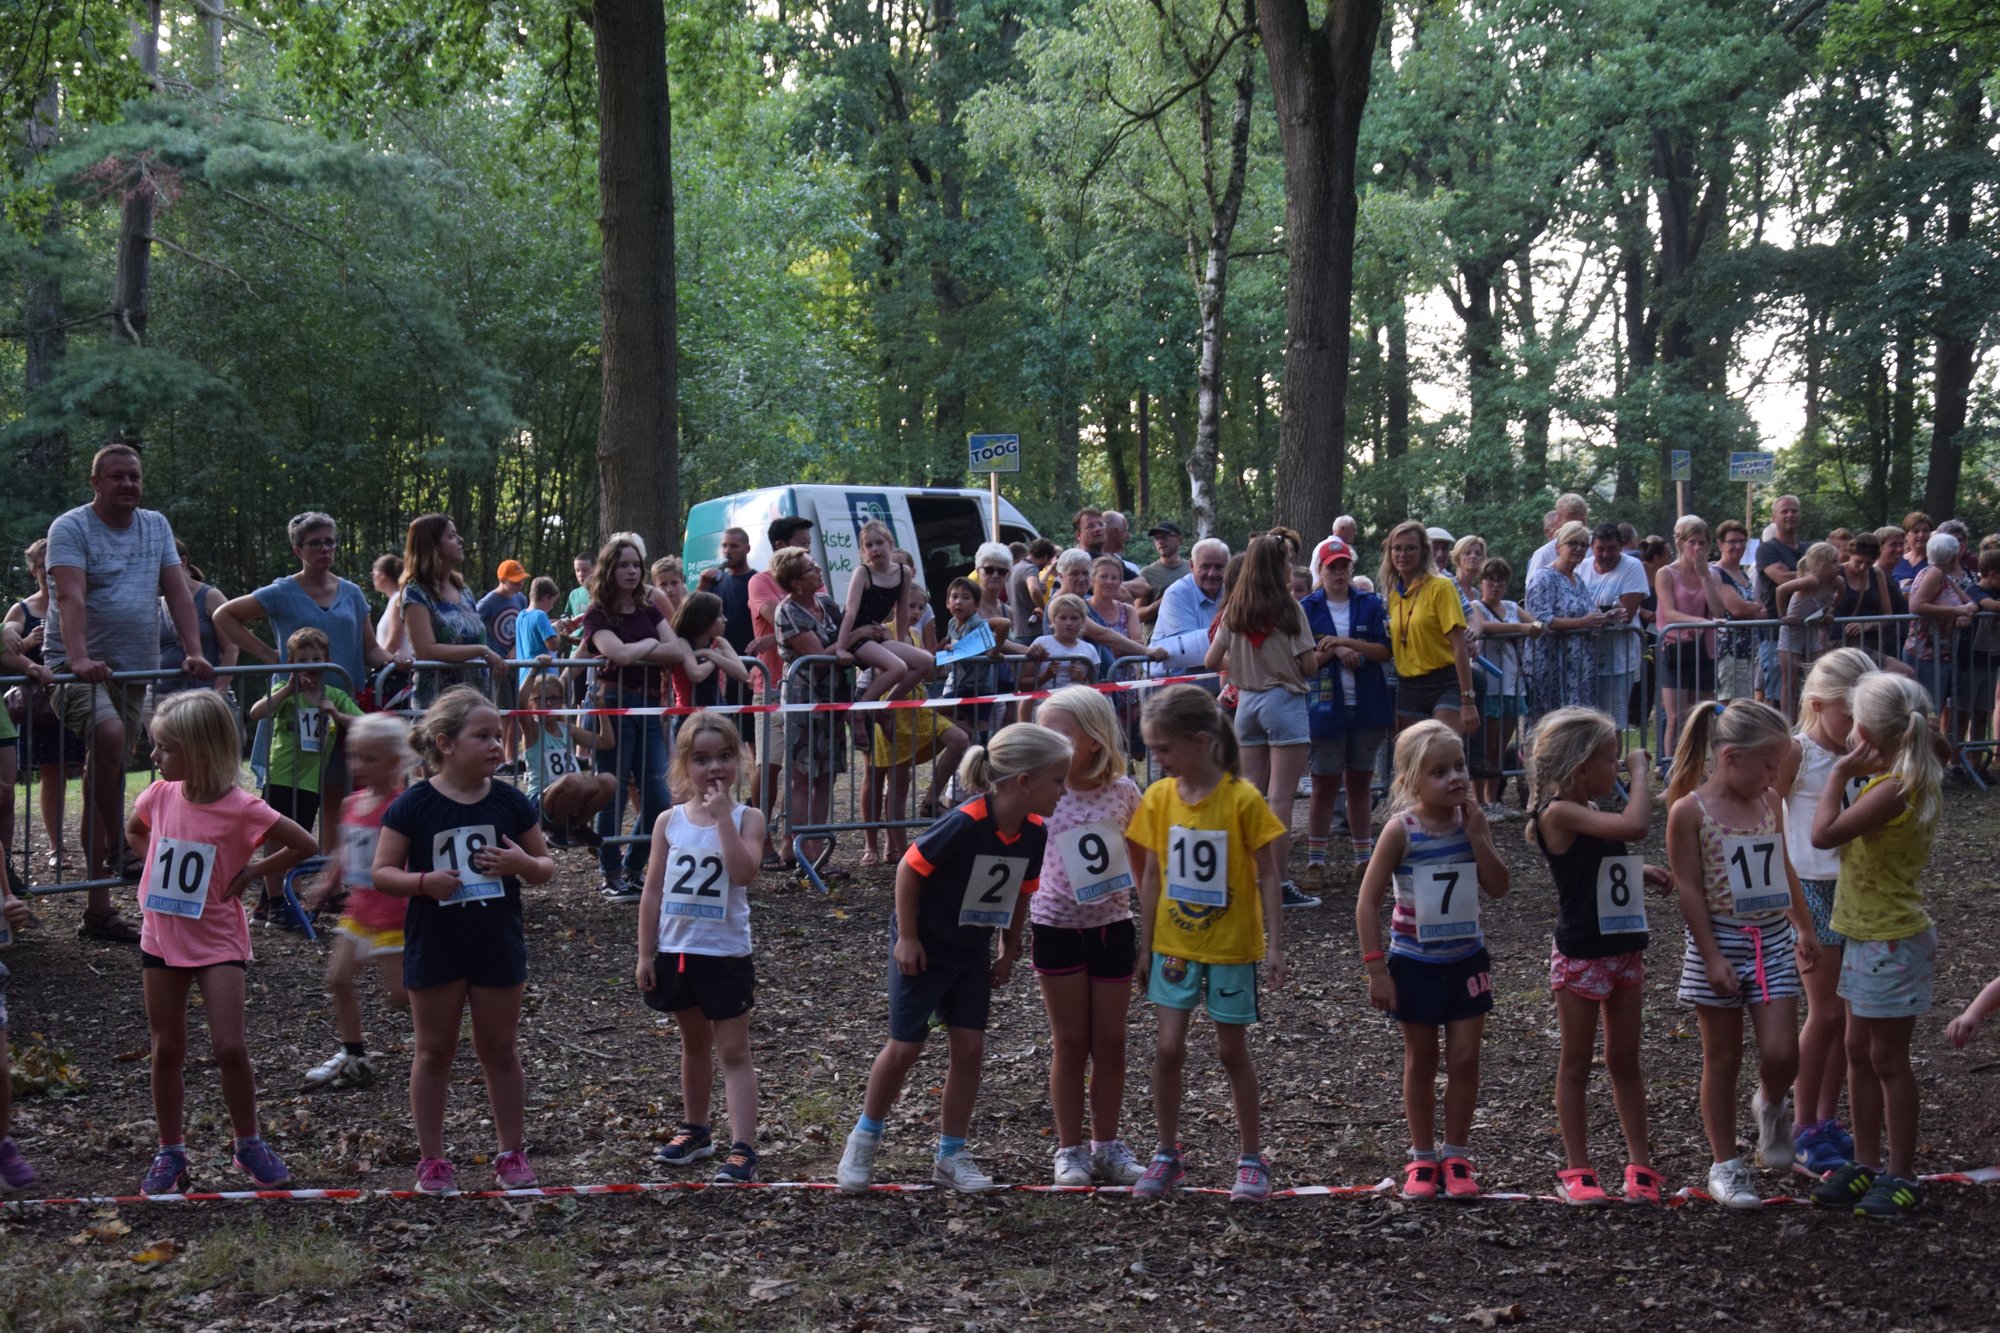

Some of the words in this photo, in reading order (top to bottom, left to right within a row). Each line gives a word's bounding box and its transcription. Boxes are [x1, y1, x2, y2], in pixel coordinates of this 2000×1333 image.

[971, 441, 1017, 462] TOOG
[159, 847, 204, 893] 10
[440, 833, 490, 876] 18
[671, 854, 723, 897] 22
[1078, 833, 1109, 875] 9
[1173, 837, 1217, 882] 19
[1731, 842, 1774, 888] 17
[978, 863, 1010, 903] 2
[1433, 871, 1459, 914] 7
[1609, 863, 1630, 907] 8
